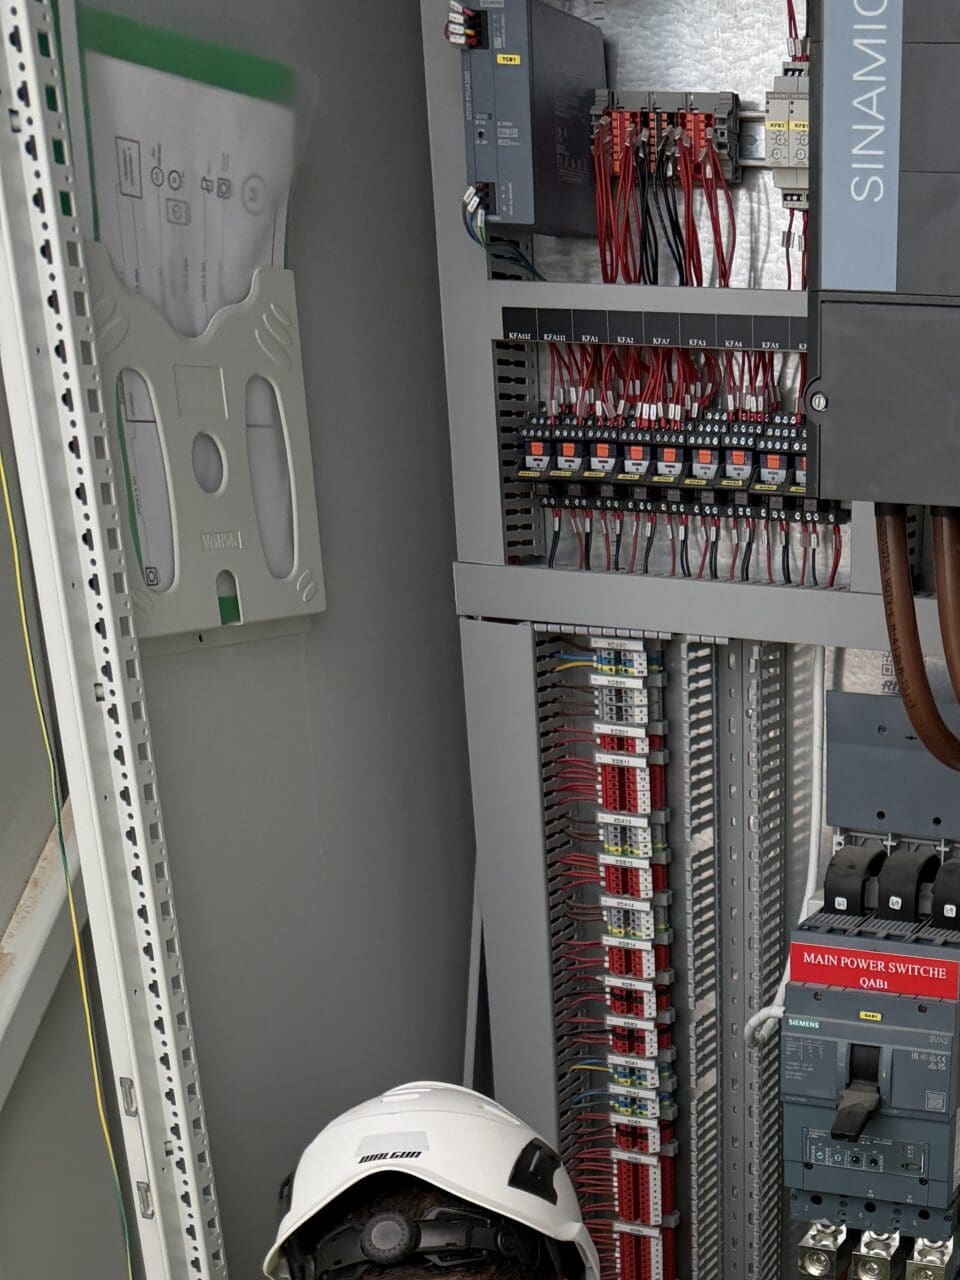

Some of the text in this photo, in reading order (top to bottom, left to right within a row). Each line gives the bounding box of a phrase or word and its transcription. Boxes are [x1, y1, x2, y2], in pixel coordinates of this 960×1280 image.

[509, 332, 531, 340] KFA112
[543, 333, 566, 341] KFA111
[581, 334, 599, 343] KFA1
[617, 336, 634, 344] KFA2
[689, 338, 706, 347] KFA3
[725, 340, 743, 348] KFA4
[761, 341, 779, 349] KFA5
[803, 952, 947, 979] MAIN POWER SWITCHE
[860, 977, 888, 989] QAB1
[788, 1019, 820, 1029] SIEMENS
